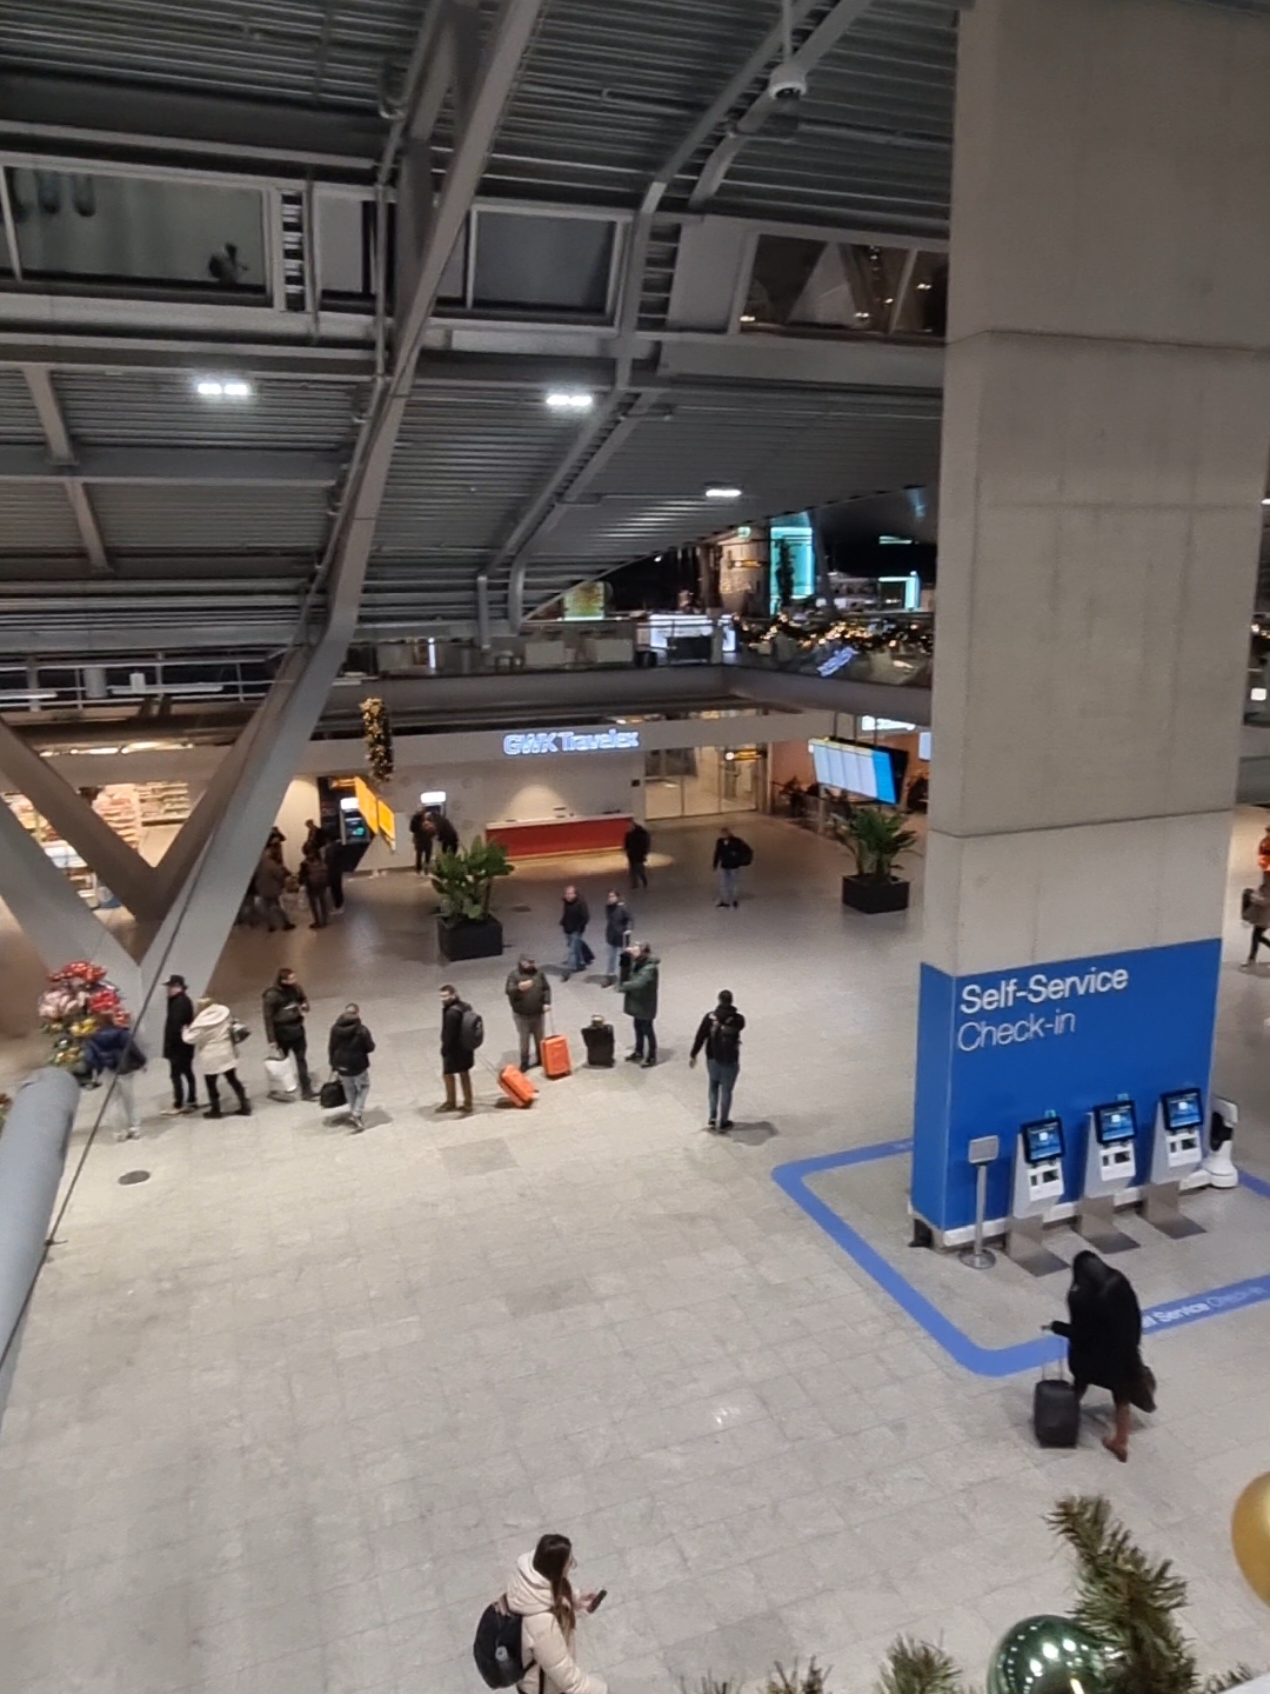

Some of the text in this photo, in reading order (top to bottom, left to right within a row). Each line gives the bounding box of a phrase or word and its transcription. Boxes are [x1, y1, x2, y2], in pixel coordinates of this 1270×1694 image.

[503, 728, 640, 755] GWK Travelex
[960, 966, 1129, 1014] Self-Service
[957, 1008, 1077, 1052] Check-in
